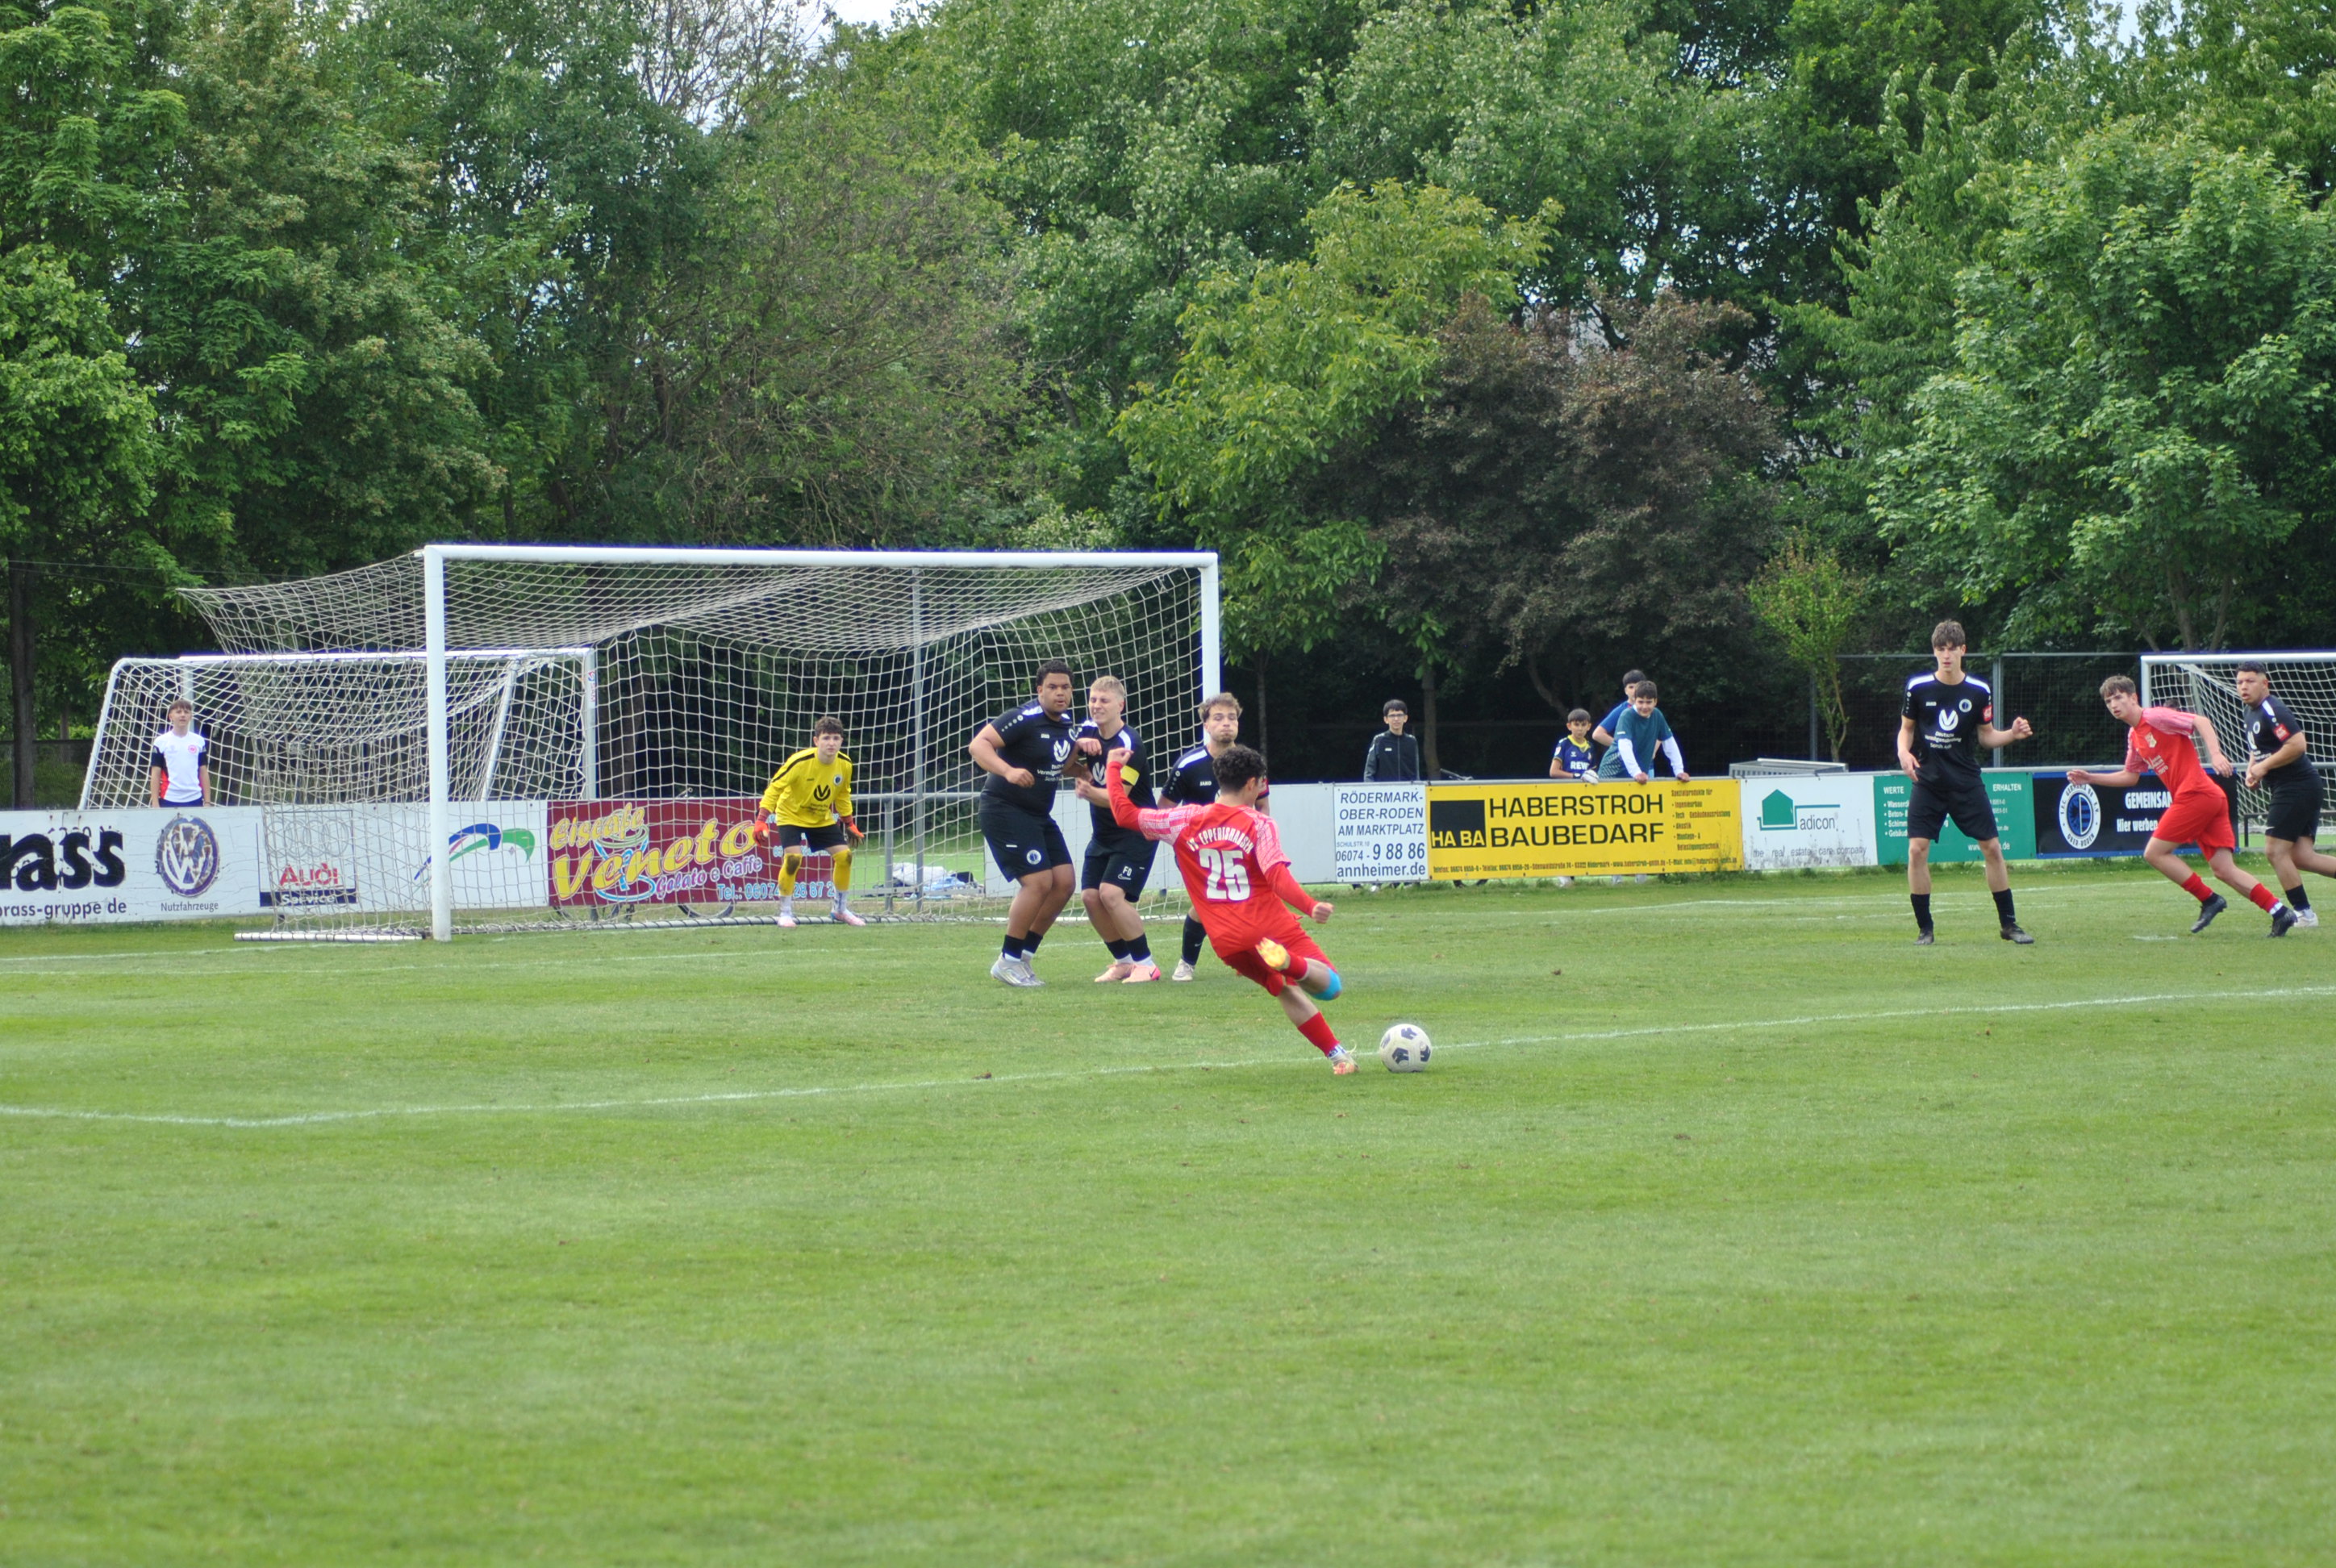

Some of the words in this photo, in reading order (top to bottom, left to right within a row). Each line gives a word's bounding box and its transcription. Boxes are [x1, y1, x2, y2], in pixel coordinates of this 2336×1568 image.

[1571, 761, 1590, 770] REW
[1883, 786, 1904, 794] WERTE
[1992, 783, 2022, 791] ERHALTEN
[1341, 790, 1423, 803] RÖDERMARK-
[1490, 794, 1664, 818] HABERSTROH
[1340, 807, 1424, 820] OBER-RODEN
[1338, 825, 1354, 836] AM
[1356, 823, 1424, 836] MARKTPLATZ
[1800, 815, 1835, 831] adicon
[2117, 819, 2131, 832] Hier
[1491, 823, 1664, 848] BAUBEDARF
[1336, 850, 1363, 861] 06074
[1373, 844, 1381, 861] 9
[1386, 843, 1403, 860] 88
[1408, 842, 1425, 860] 86
[553, 818, 756, 901] Veneto
[1199, 848, 1251, 901] 25
[1337, 861, 1425, 878] annheimer.de
[161, 901, 219, 913] Nutzfahrzeuge
